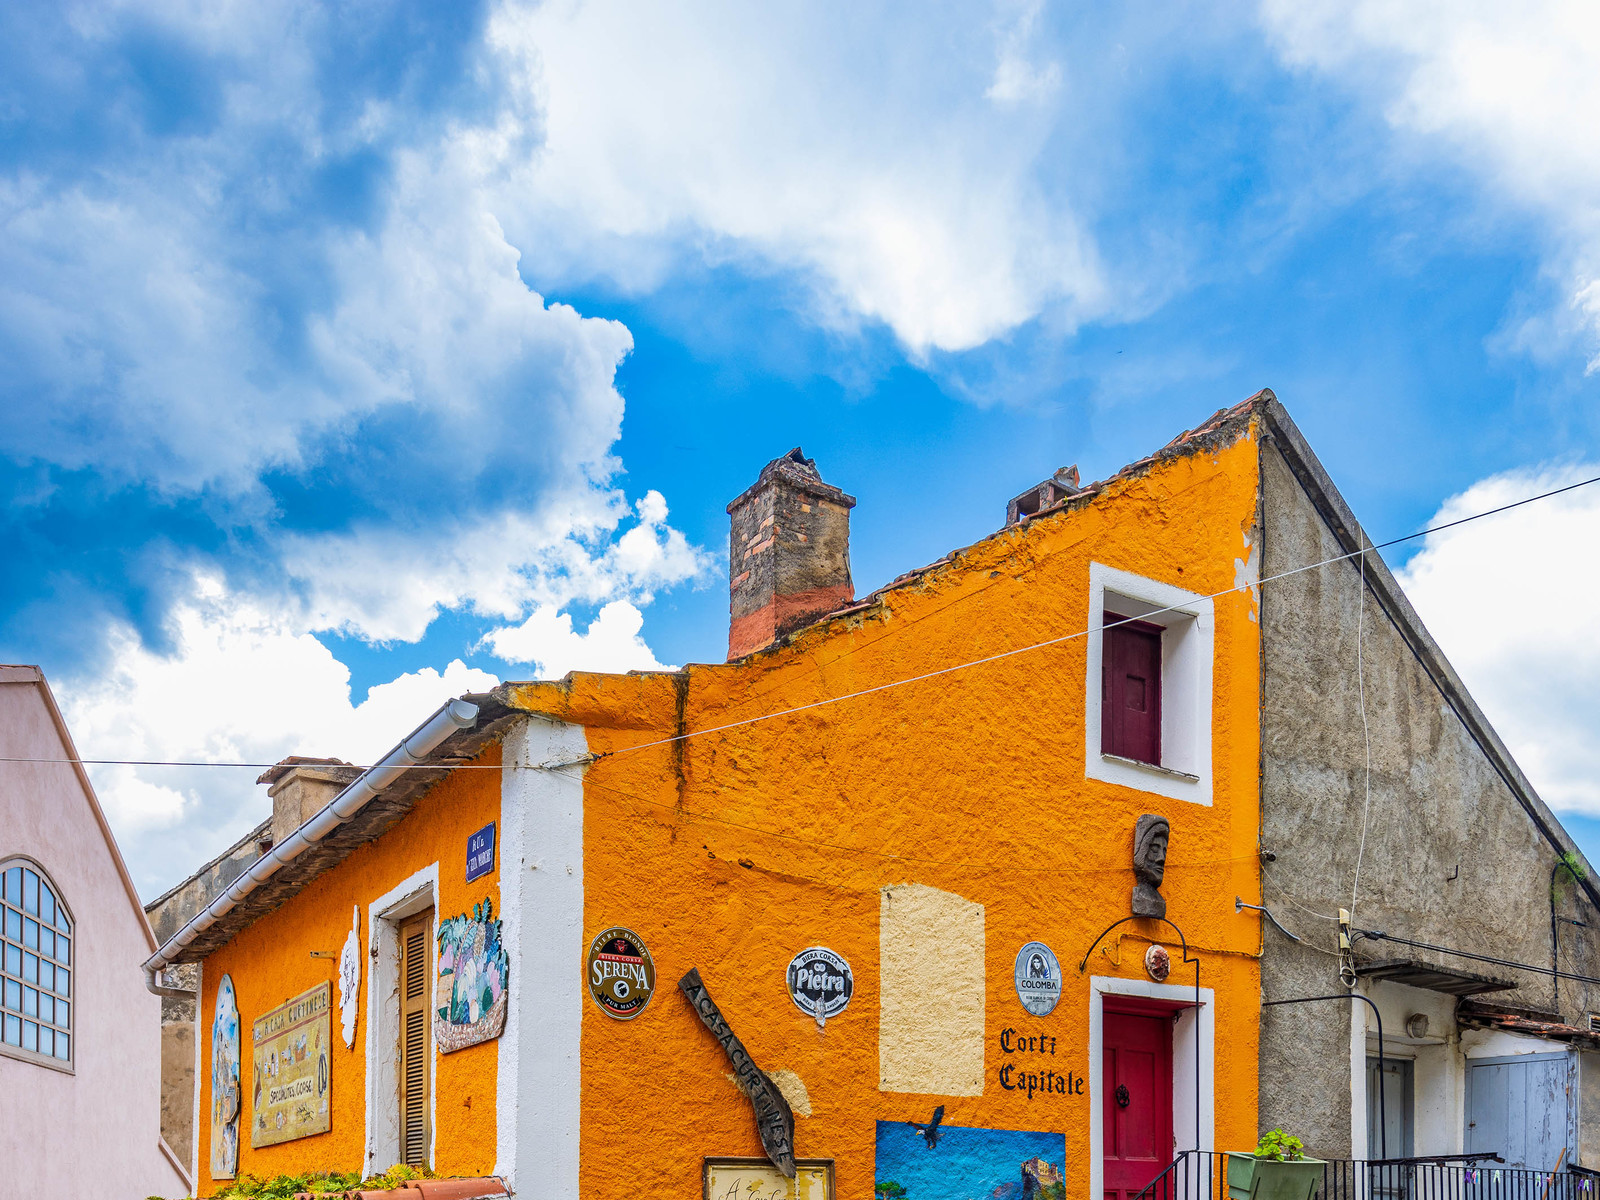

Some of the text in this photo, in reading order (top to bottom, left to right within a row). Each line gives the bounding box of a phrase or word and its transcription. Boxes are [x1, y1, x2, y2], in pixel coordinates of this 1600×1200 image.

[601, 954, 642, 964] BIERA CORSA
[801, 952, 838, 966] BIERA CORSA
[592, 959, 650, 991] SERENA
[796, 968, 845, 992] Pietra
[1021, 979, 1057, 990] COLOMBA
[620, 999, 637, 1009] MALT
[686, 984, 703, 1000] A
[699, 997, 736, 1048] CASA
[1000, 1027, 1057, 1055] Corti
[999, 1063, 1085, 1100] Capitale
